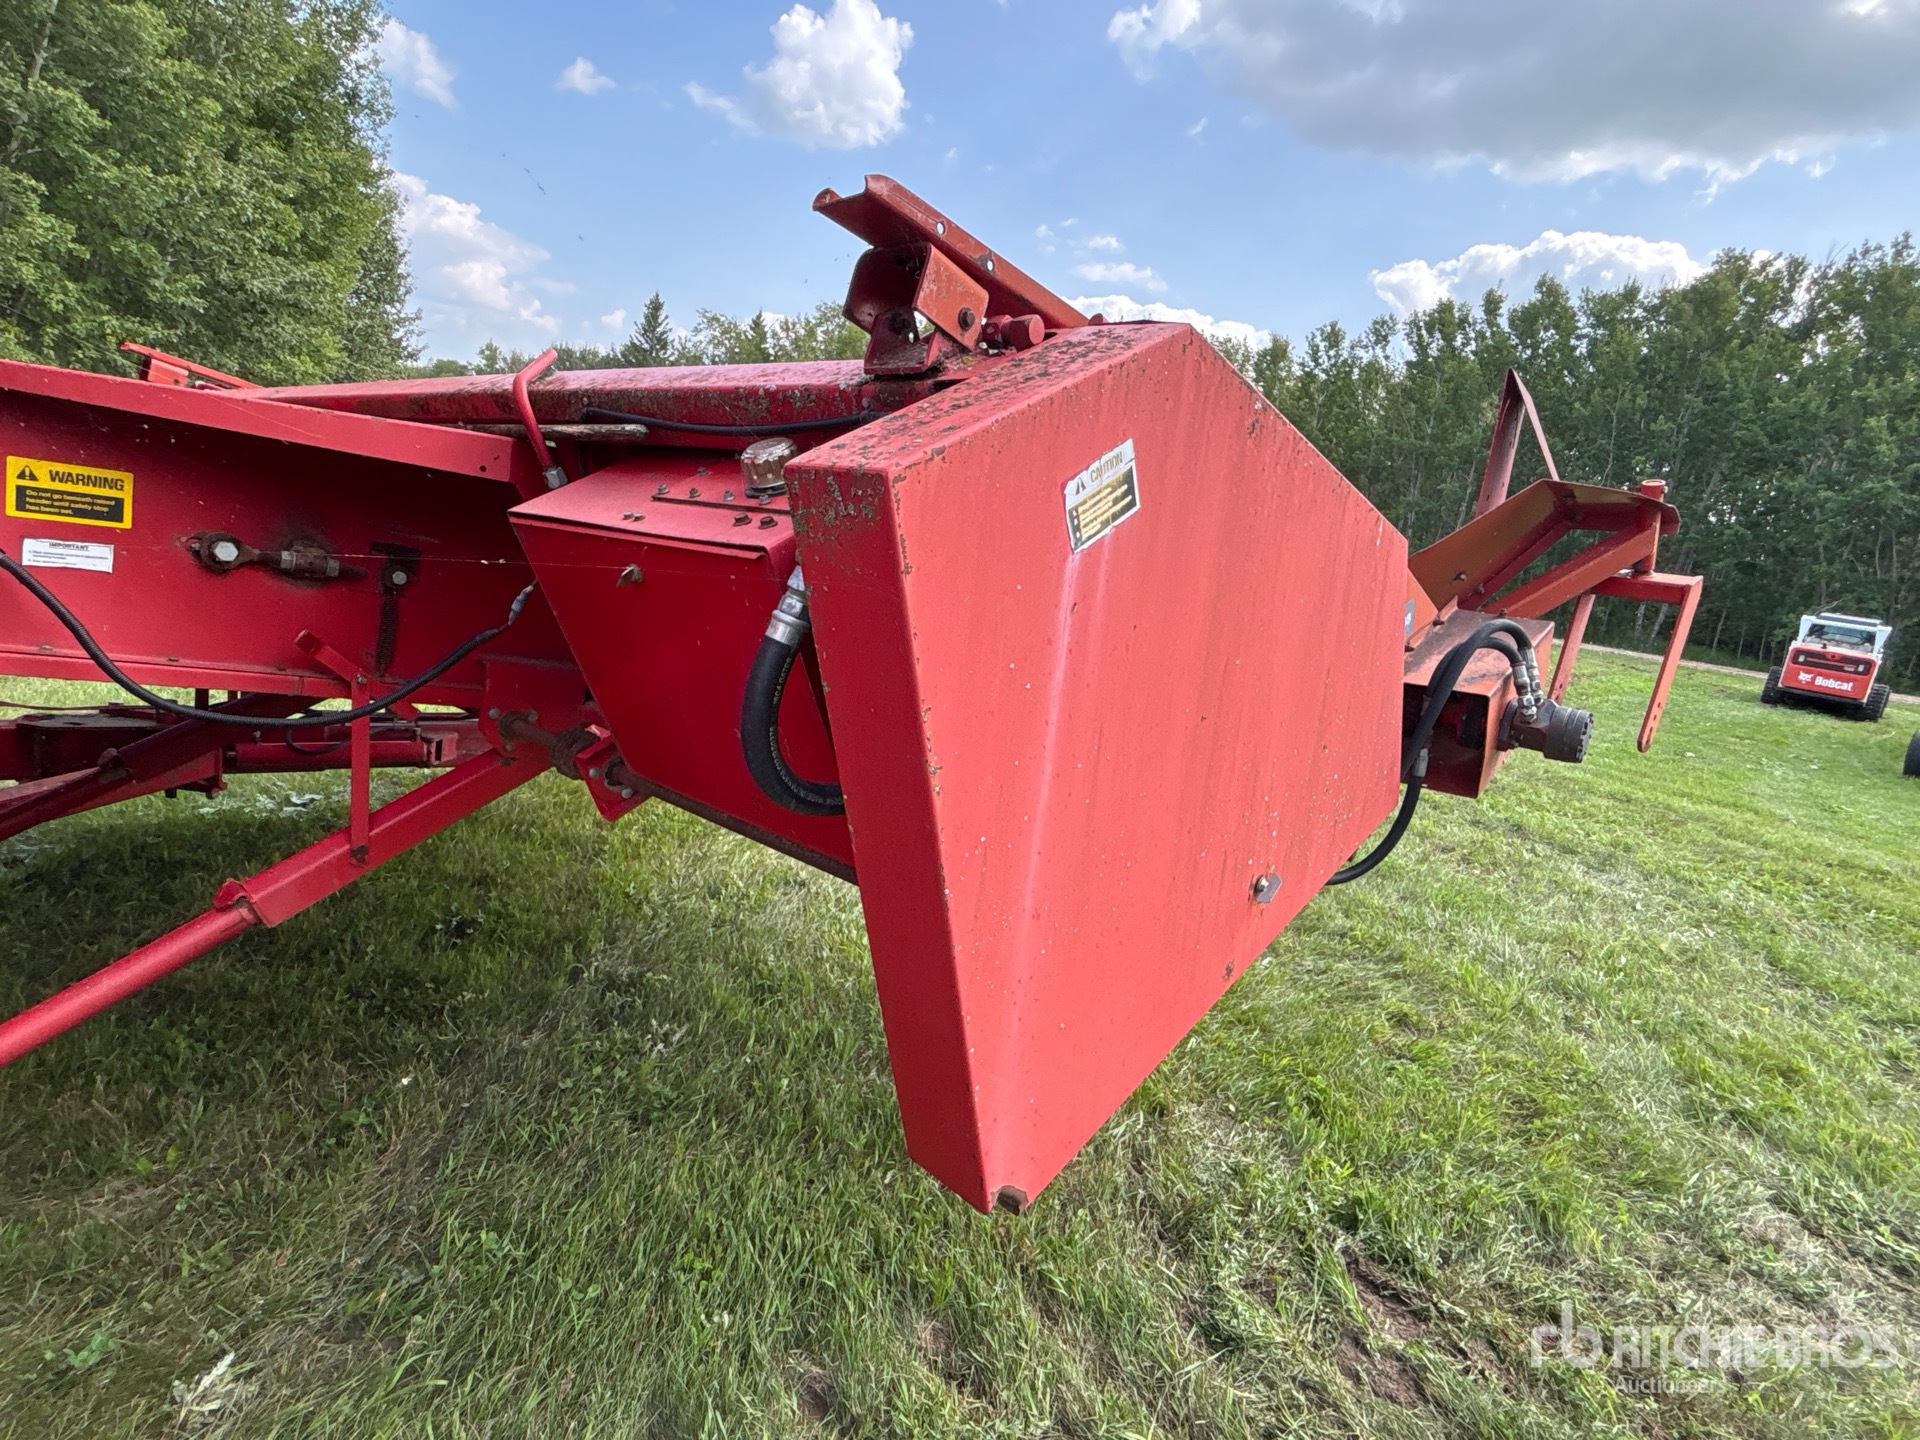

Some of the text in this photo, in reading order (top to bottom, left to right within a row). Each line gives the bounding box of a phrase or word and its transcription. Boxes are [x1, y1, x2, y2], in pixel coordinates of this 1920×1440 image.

[1090, 451, 1123, 483] CAUTION
[49, 470, 125, 491] WARNING
[40, 505, 59, 513] been
[49, 542, 89, 550] IMPORTANT
[1814, 676, 1854, 691] Bobcat
